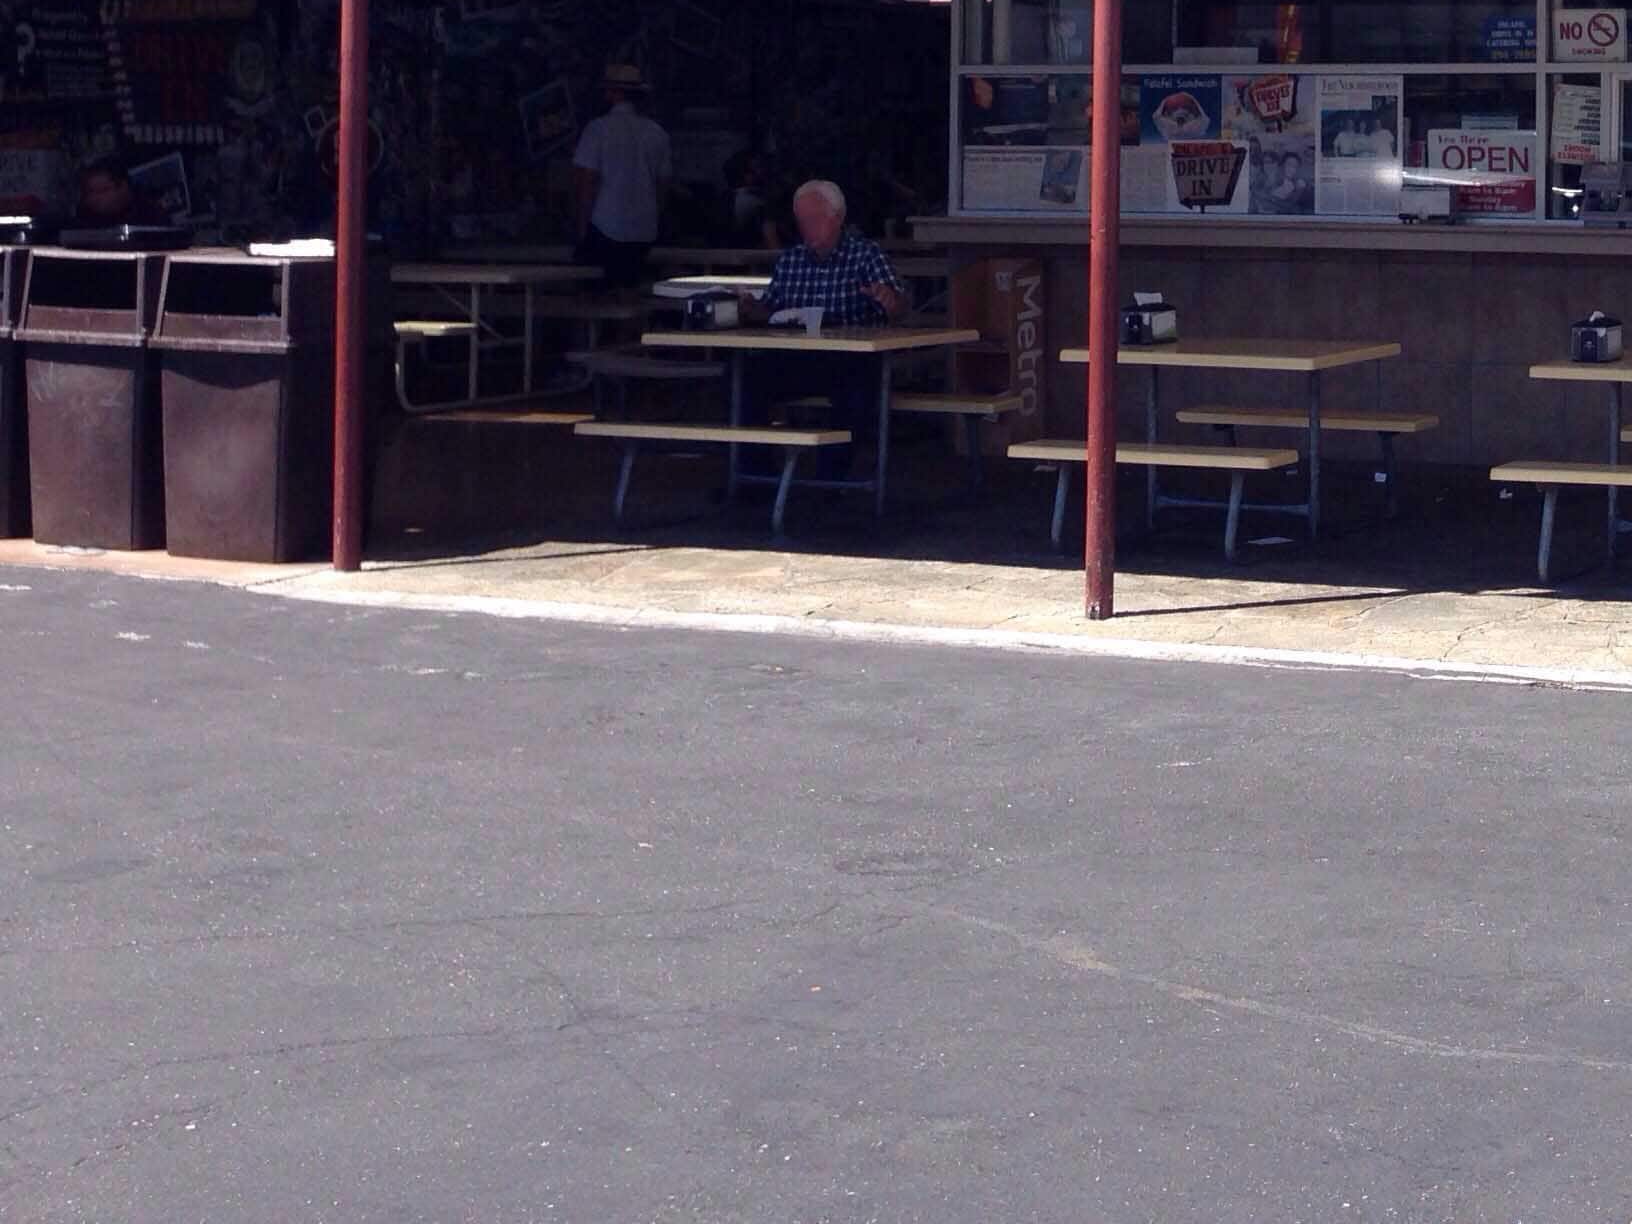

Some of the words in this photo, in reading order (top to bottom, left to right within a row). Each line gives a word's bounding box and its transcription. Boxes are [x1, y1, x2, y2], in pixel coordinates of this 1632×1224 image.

[1560, 22, 1583, 41] NO
[1175, 158, 1232, 177] DRIVE
[1441, 145, 1530, 173] OPEN
[1190, 179, 1213, 197] IN
